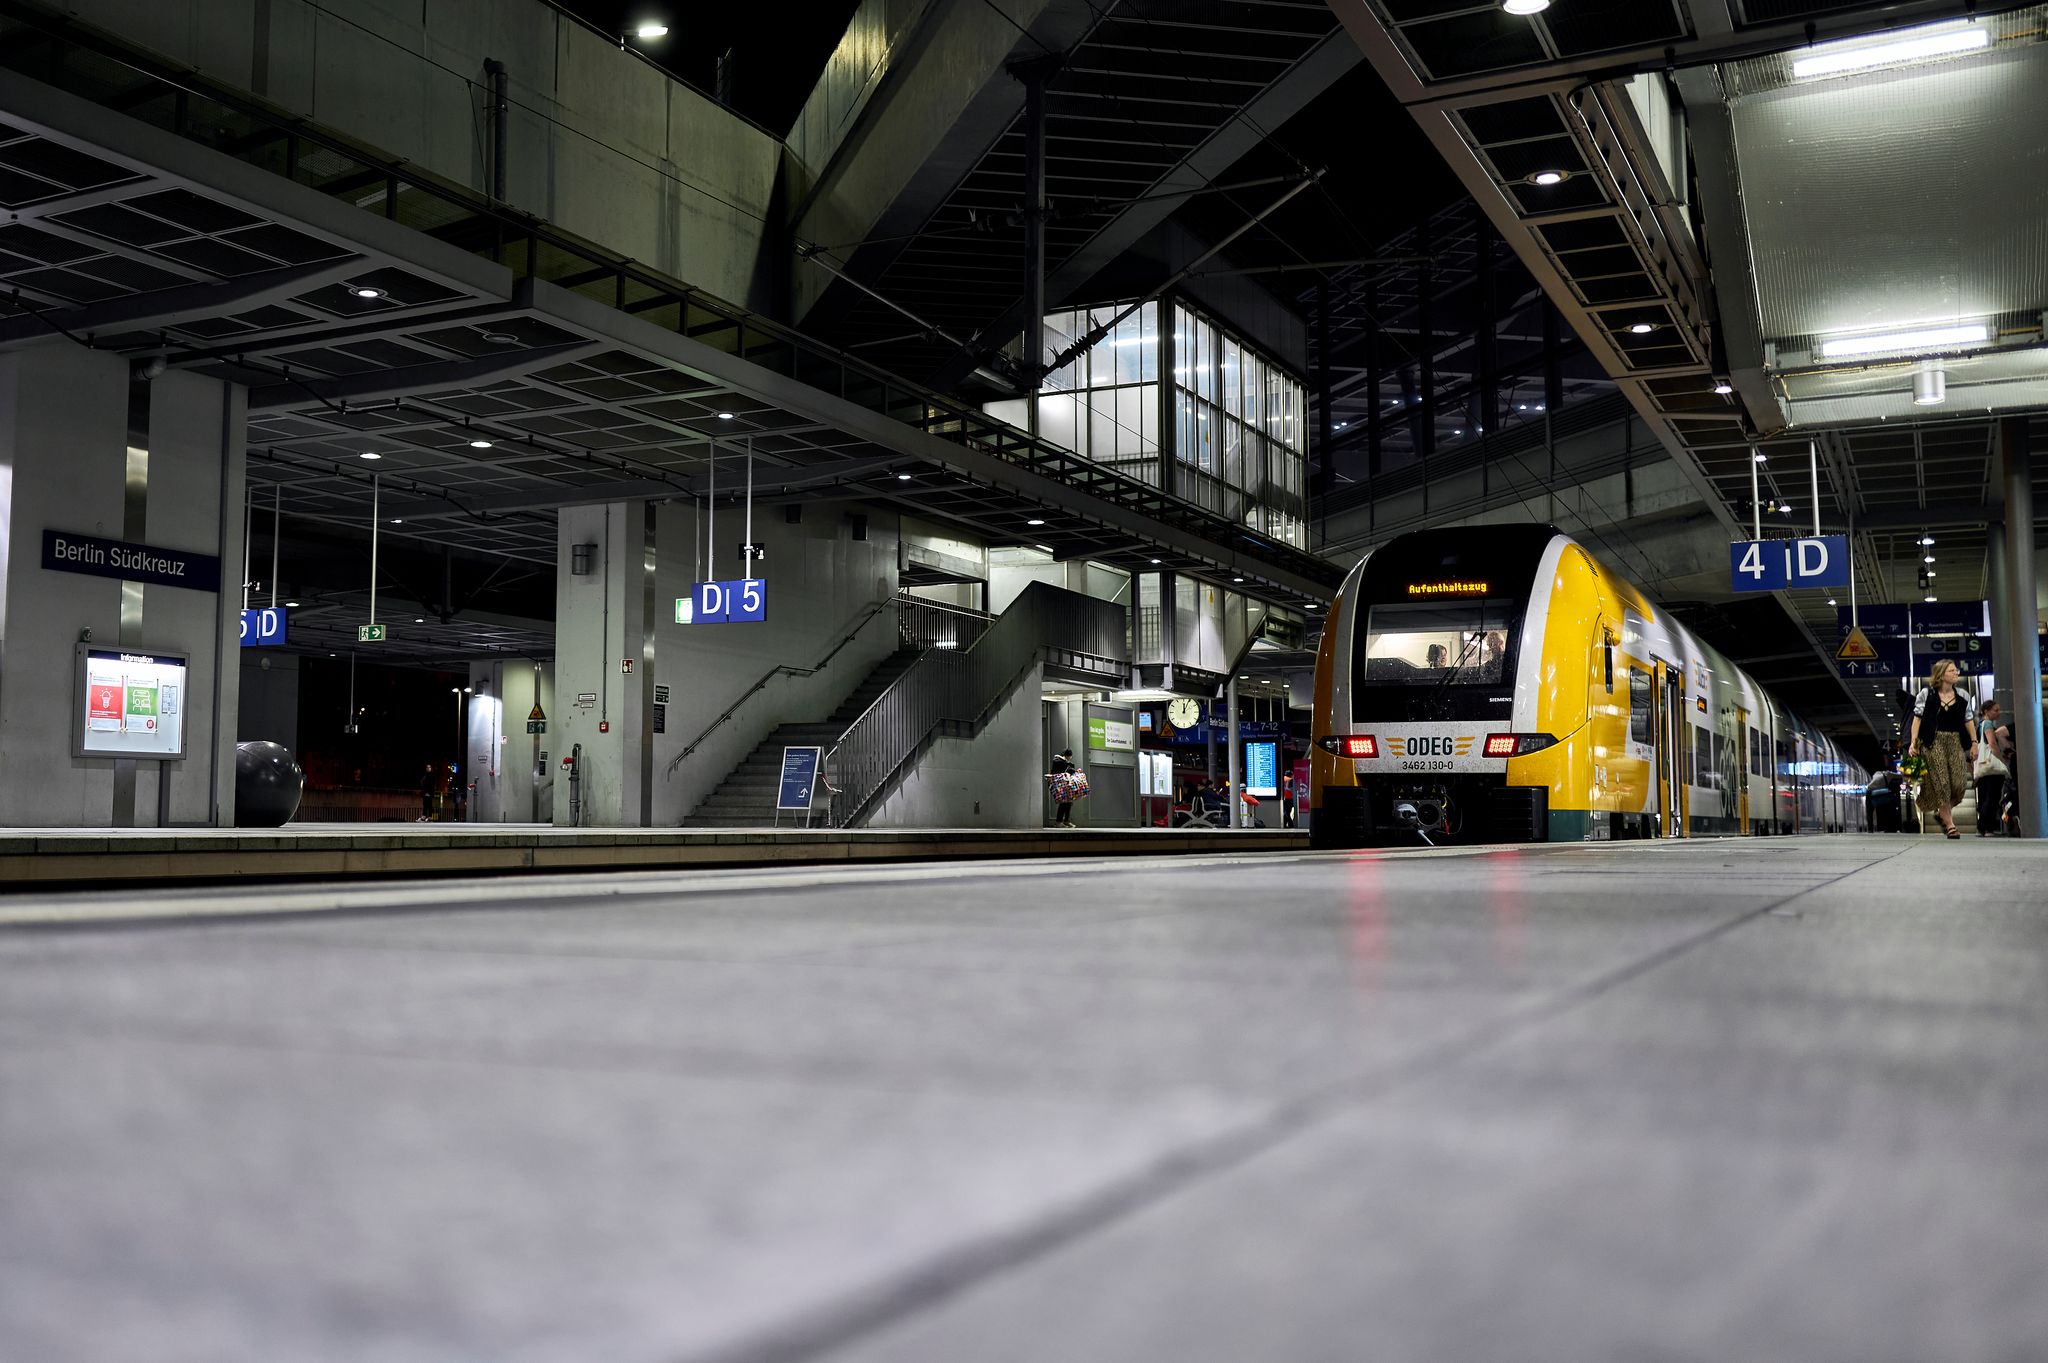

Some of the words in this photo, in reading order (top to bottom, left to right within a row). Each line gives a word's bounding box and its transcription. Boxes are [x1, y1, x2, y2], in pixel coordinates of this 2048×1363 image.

[54, 539, 104, 565] Berlin
[110, 547, 185, 576] Südkreuz
[1739, 543, 1765, 579] 4
[1798, 540, 1828, 577] D
[1409, 582, 1487, 594] Aufenthaltszug
[703, 584, 722, 615] D
[742, 581, 760, 612] 5
[262, 610, 278, 637] D
[120, 653, 154, 664] Information
[1261, 722, 1279, 731] 7-12
[1407, 737, 1453, 756] ODEG
[1402, 761, 1426, 770] 3462
[1428, 761, 1453, 770] 130-0
